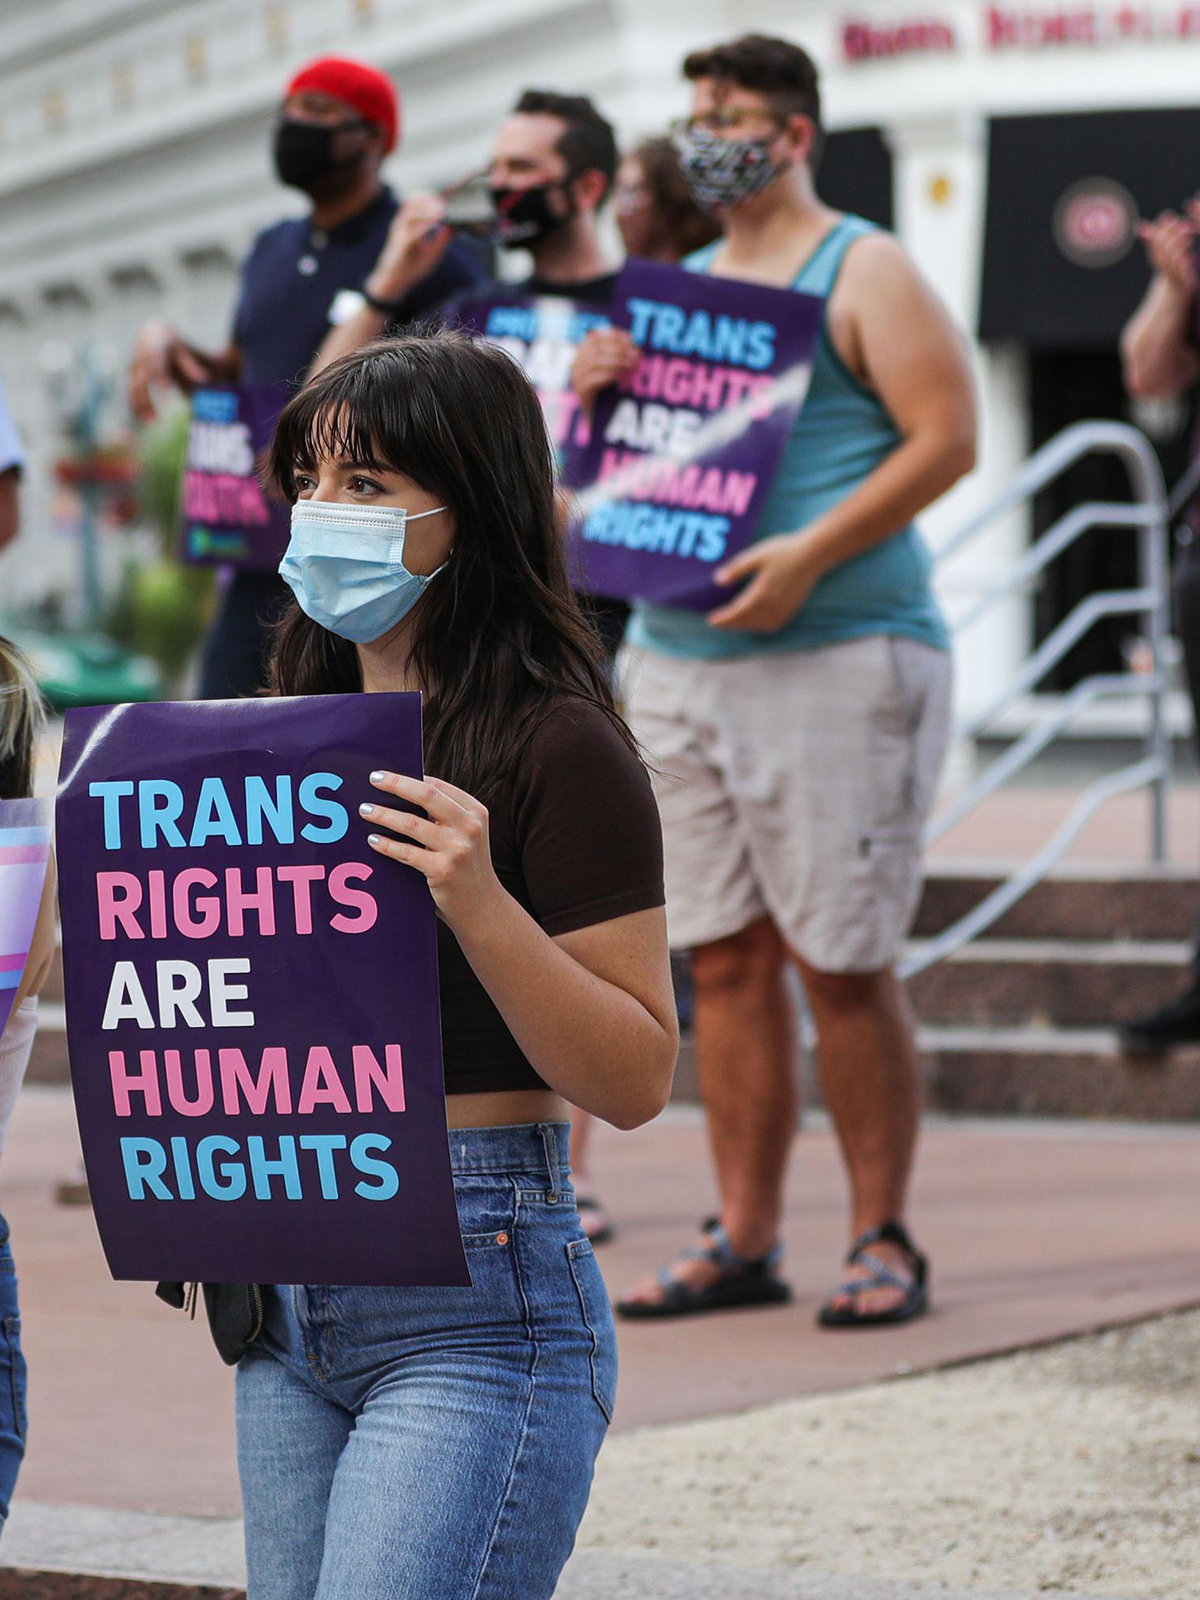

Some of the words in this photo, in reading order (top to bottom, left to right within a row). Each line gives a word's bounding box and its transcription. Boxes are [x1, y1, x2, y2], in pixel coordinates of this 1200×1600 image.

[627, 297, 777, 370] TRANS
[604, 397, 702, 459] ARE
[581, 499, 731, 564] RIGHTS
[89, 772, 349, 850] TRANS
[96, 862, 379, 940] RIGHTS
[101, 957, 255, 1030] ARE
[108, 1044, 406, 1117] HUMAN
[119, 1132, 400, 1201] RIGHTS
